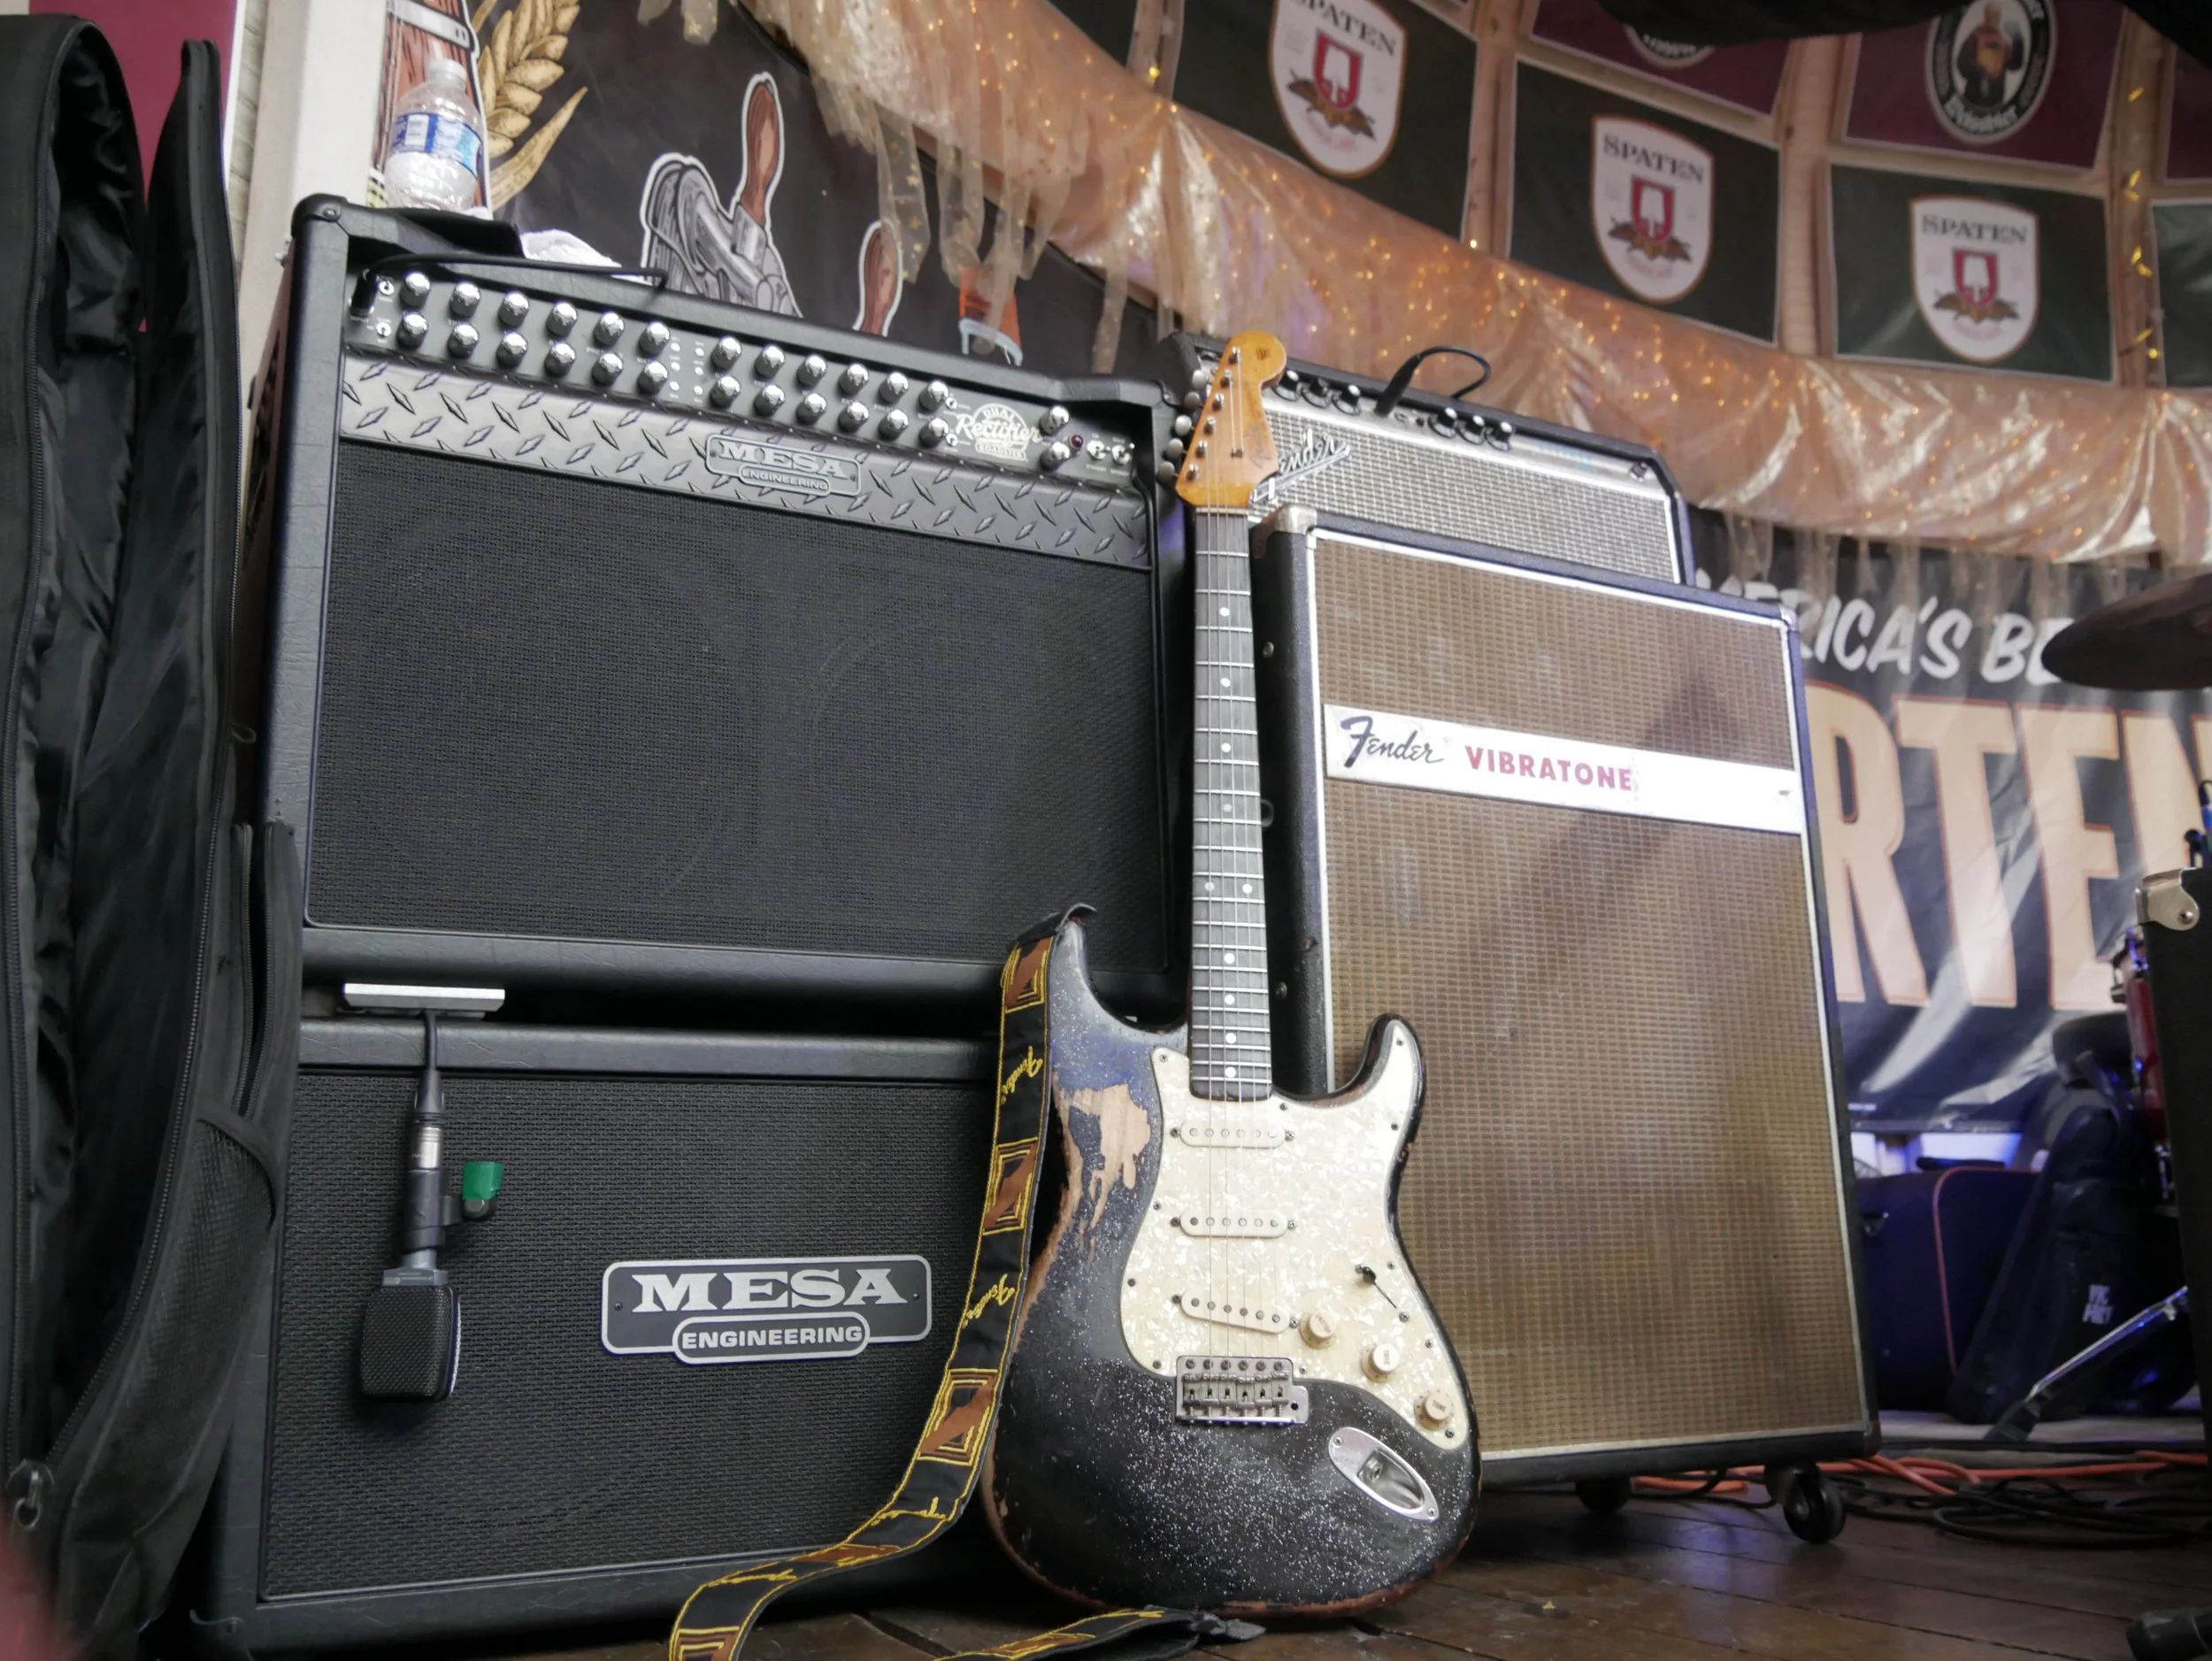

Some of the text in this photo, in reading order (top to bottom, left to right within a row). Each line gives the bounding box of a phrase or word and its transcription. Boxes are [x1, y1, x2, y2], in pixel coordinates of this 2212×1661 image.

[1300, 0, 1395, 57] PATEN
[1602, 132, 1705, 185] SPATEN
[1921, 212, 2028, 244] SPATEN
[718, 440, 849, 481] MESA
[741, 468, 829, 490] ENGINEERING
[1696, 567, 1973, 681] RICA'S
[1340, 715, 1632, 792] Fender VIBRATONE
[630, 1267, 909, 1313] MESA
[681, 1326, 863, 1350] ENGINEERING
